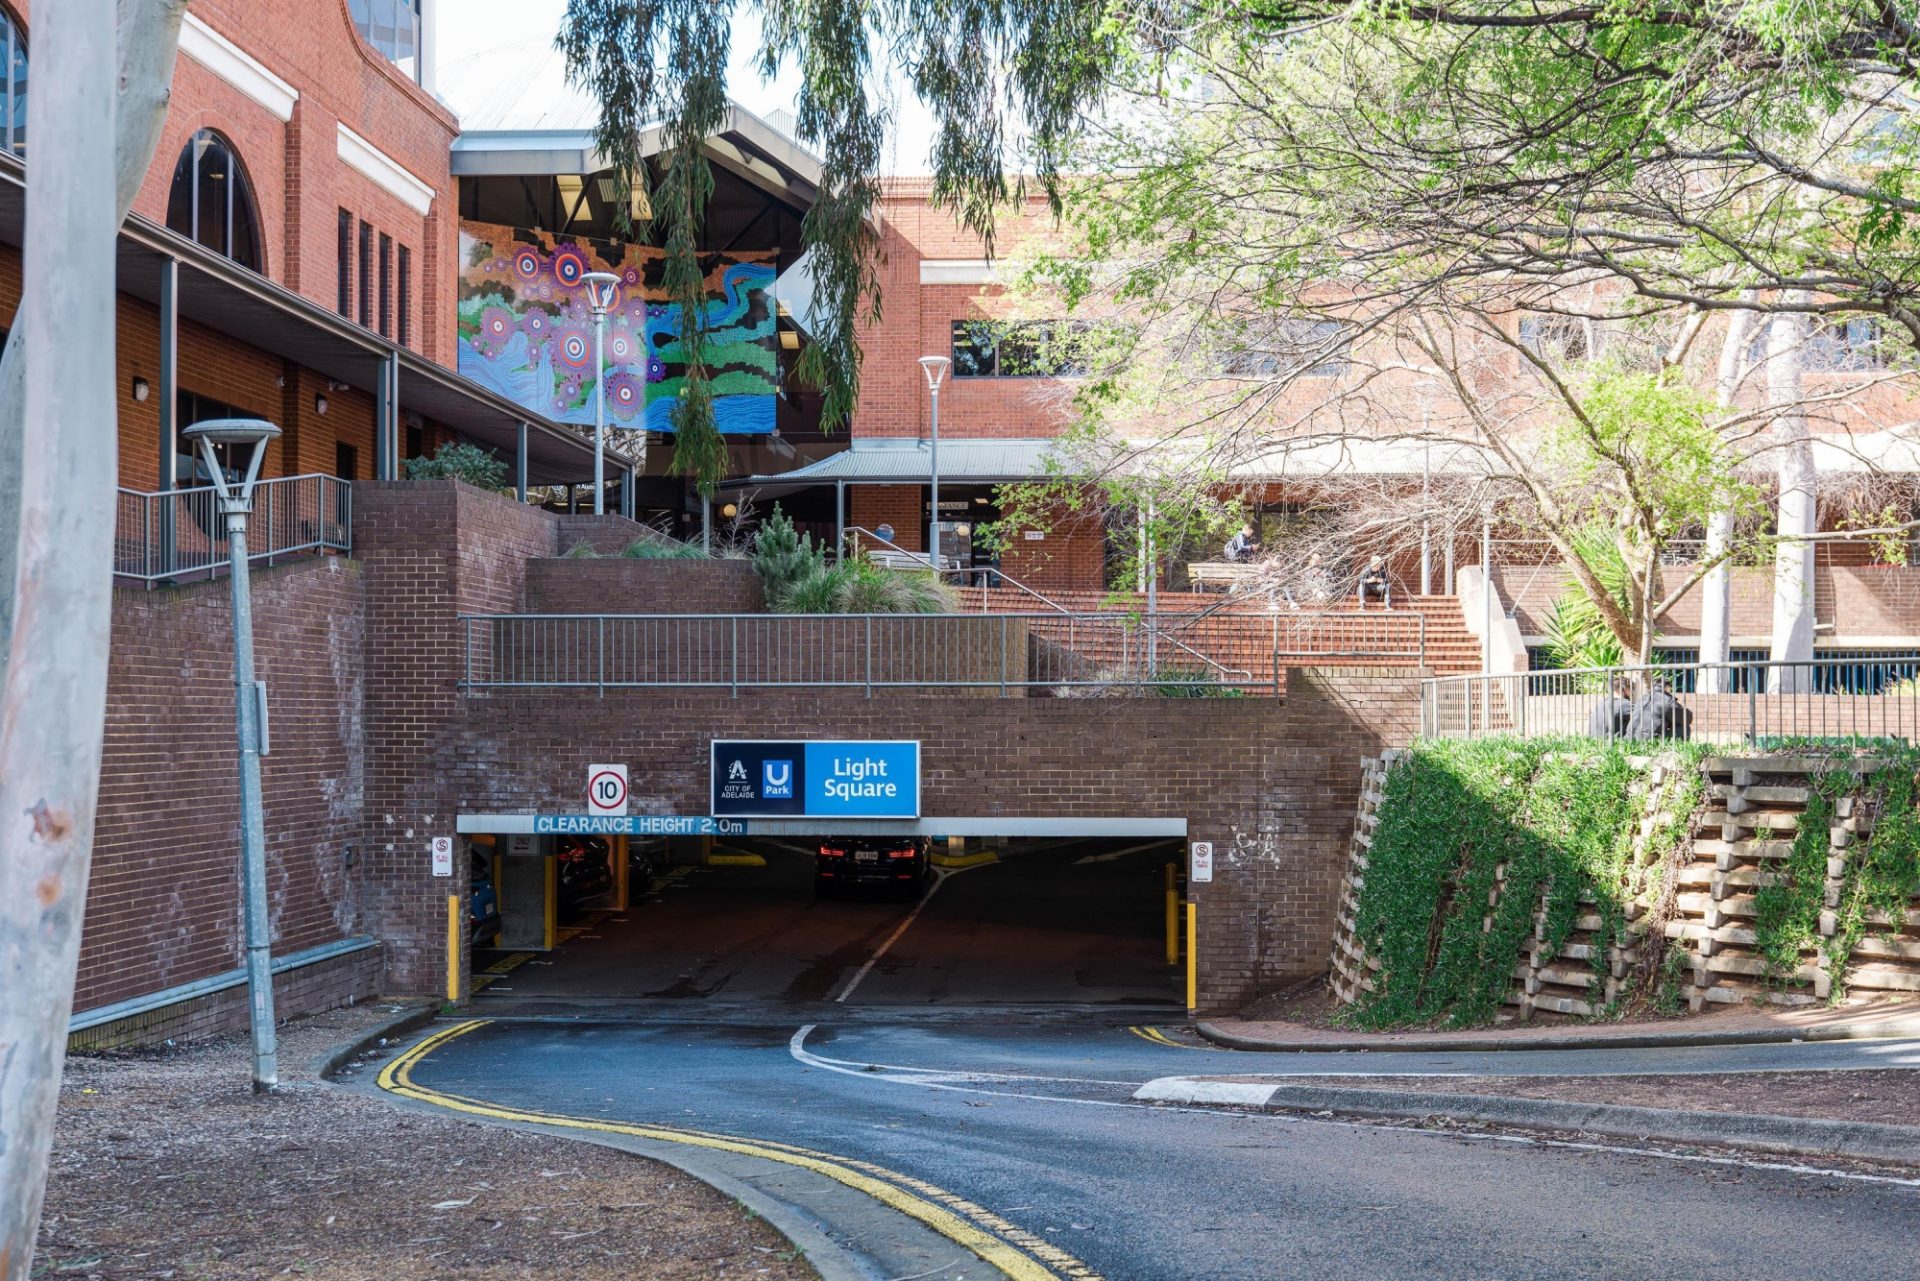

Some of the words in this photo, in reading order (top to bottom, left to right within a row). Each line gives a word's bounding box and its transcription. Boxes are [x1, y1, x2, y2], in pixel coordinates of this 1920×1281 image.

[766, 764, 789, 785] U
[834, 758, 888, 780] Light
[598, 781, 617, 799] 10
[766, 786, 789, 795] Park
[824, 779, 897, 801] Square
[538, 816, 633, 833] CLEARANCE
[640, 816, 694, 833] HEIGHT
